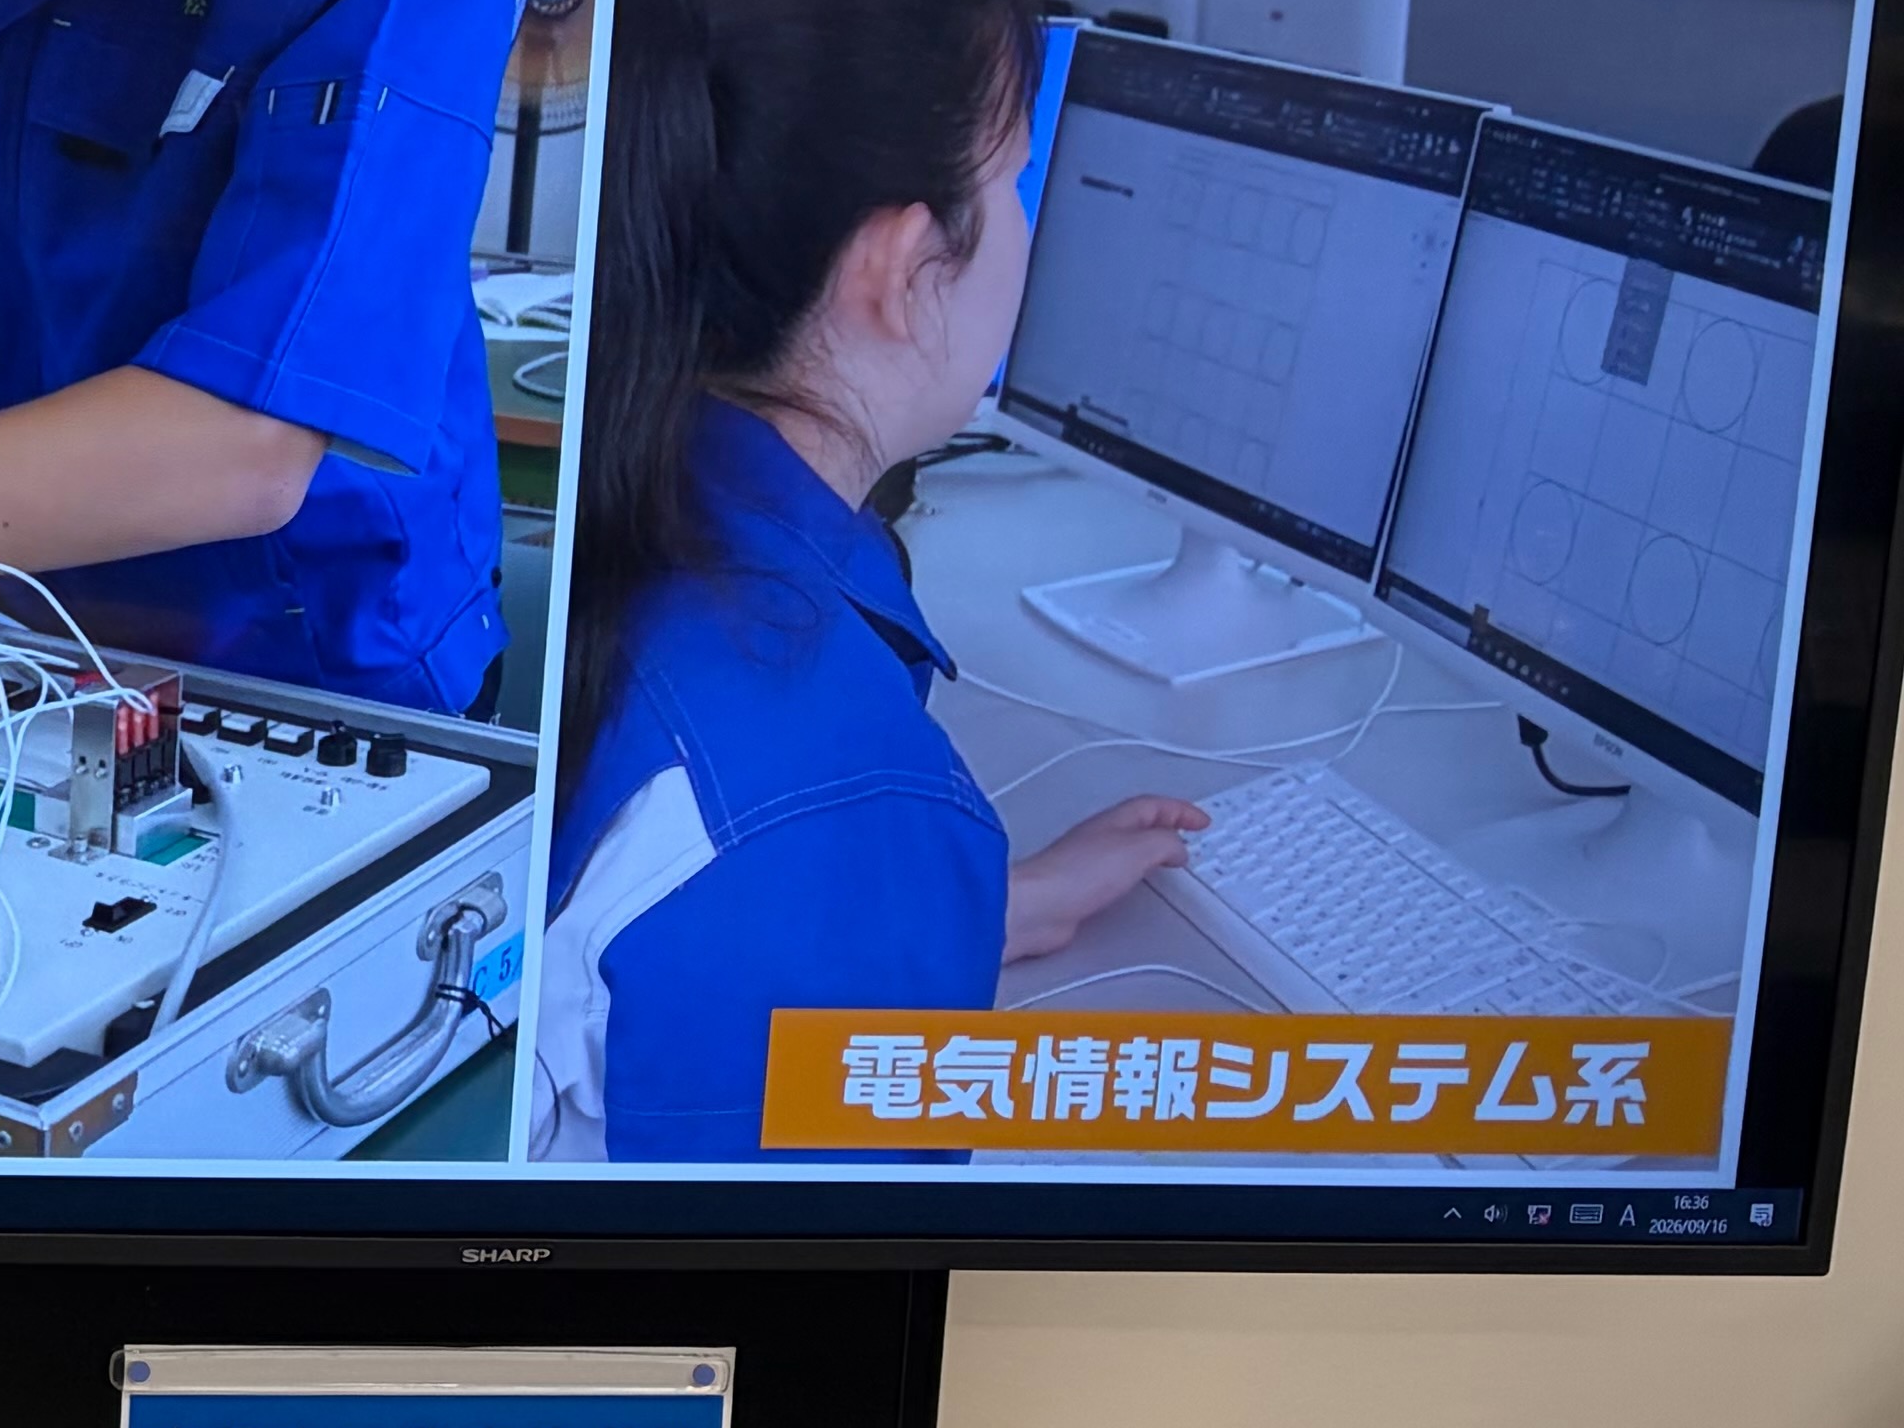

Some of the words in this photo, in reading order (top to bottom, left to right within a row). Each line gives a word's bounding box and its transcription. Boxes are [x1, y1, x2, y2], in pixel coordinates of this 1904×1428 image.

[840, 1033, 1653, 1128] 電気情報システム系
[1673, 1194, 1709, 1211] 16:36
[1619, 1204, 1636, 1227] A
[1648, 1218, 1728, 1236] 2026/09/16
[462, 1248, 551, 1263] SHARP
